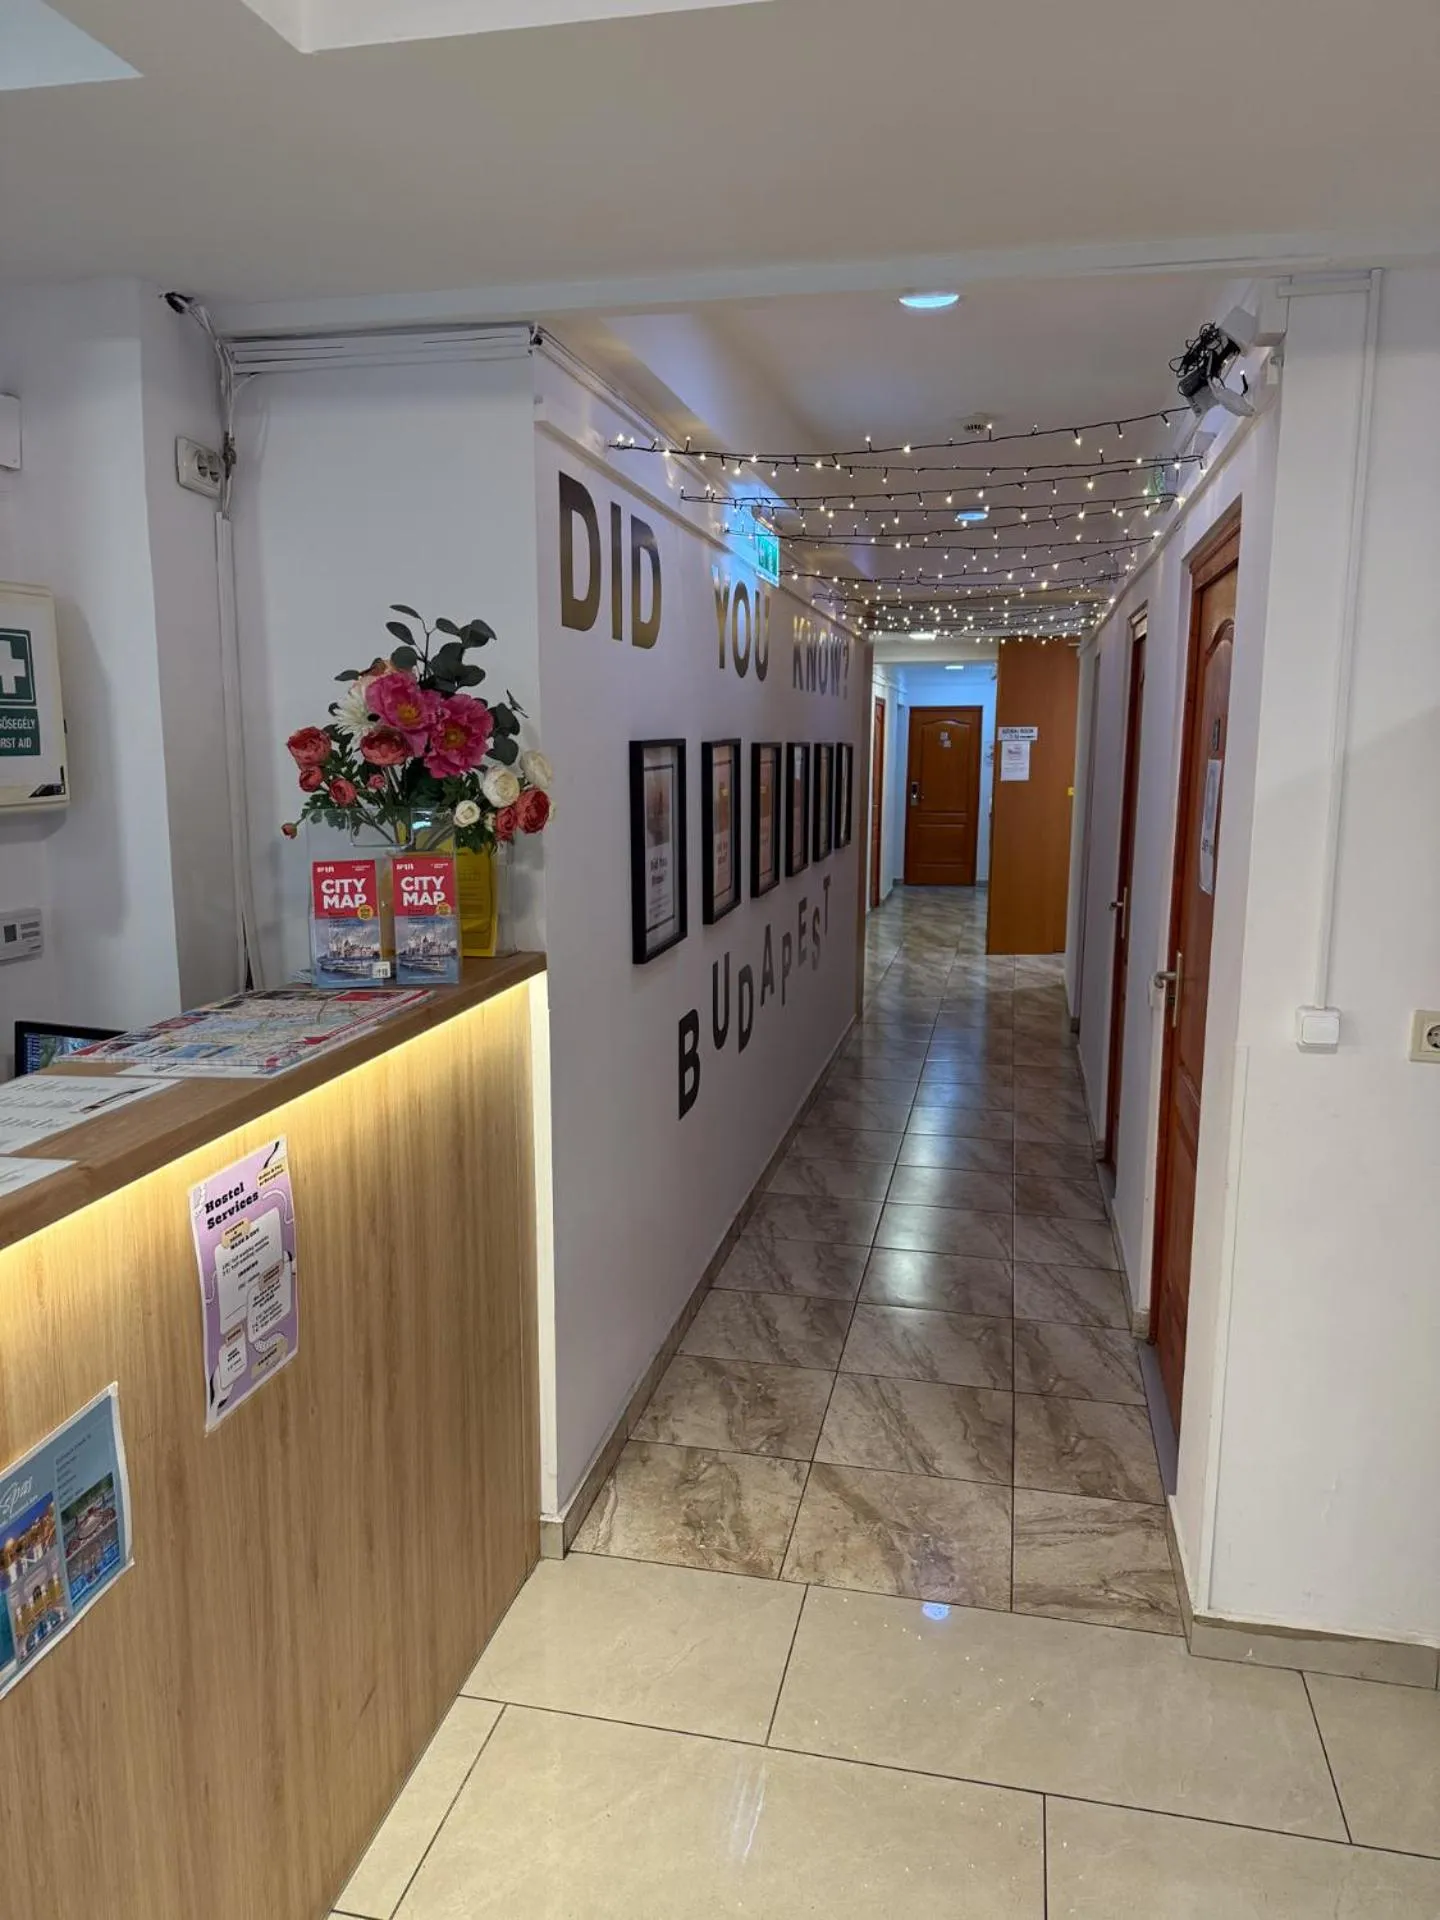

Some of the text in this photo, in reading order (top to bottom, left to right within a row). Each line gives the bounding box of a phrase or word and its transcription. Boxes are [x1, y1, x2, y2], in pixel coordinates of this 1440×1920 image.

[559, 470, 850, 699] DID YOU KNOW?
[18, 737, 32, 749] AID
[321, 878, 366, 894] CITY
[401, 875, 444, 891] CITY
[323, 894, 367, 910] MAP
[402, 891, 446, 906] MAP
[678, 875, 831, 1121] BUDAPEST
[205, 1182, 245, 1215] Hostel
[207, 1191, 260, 1231] Services
